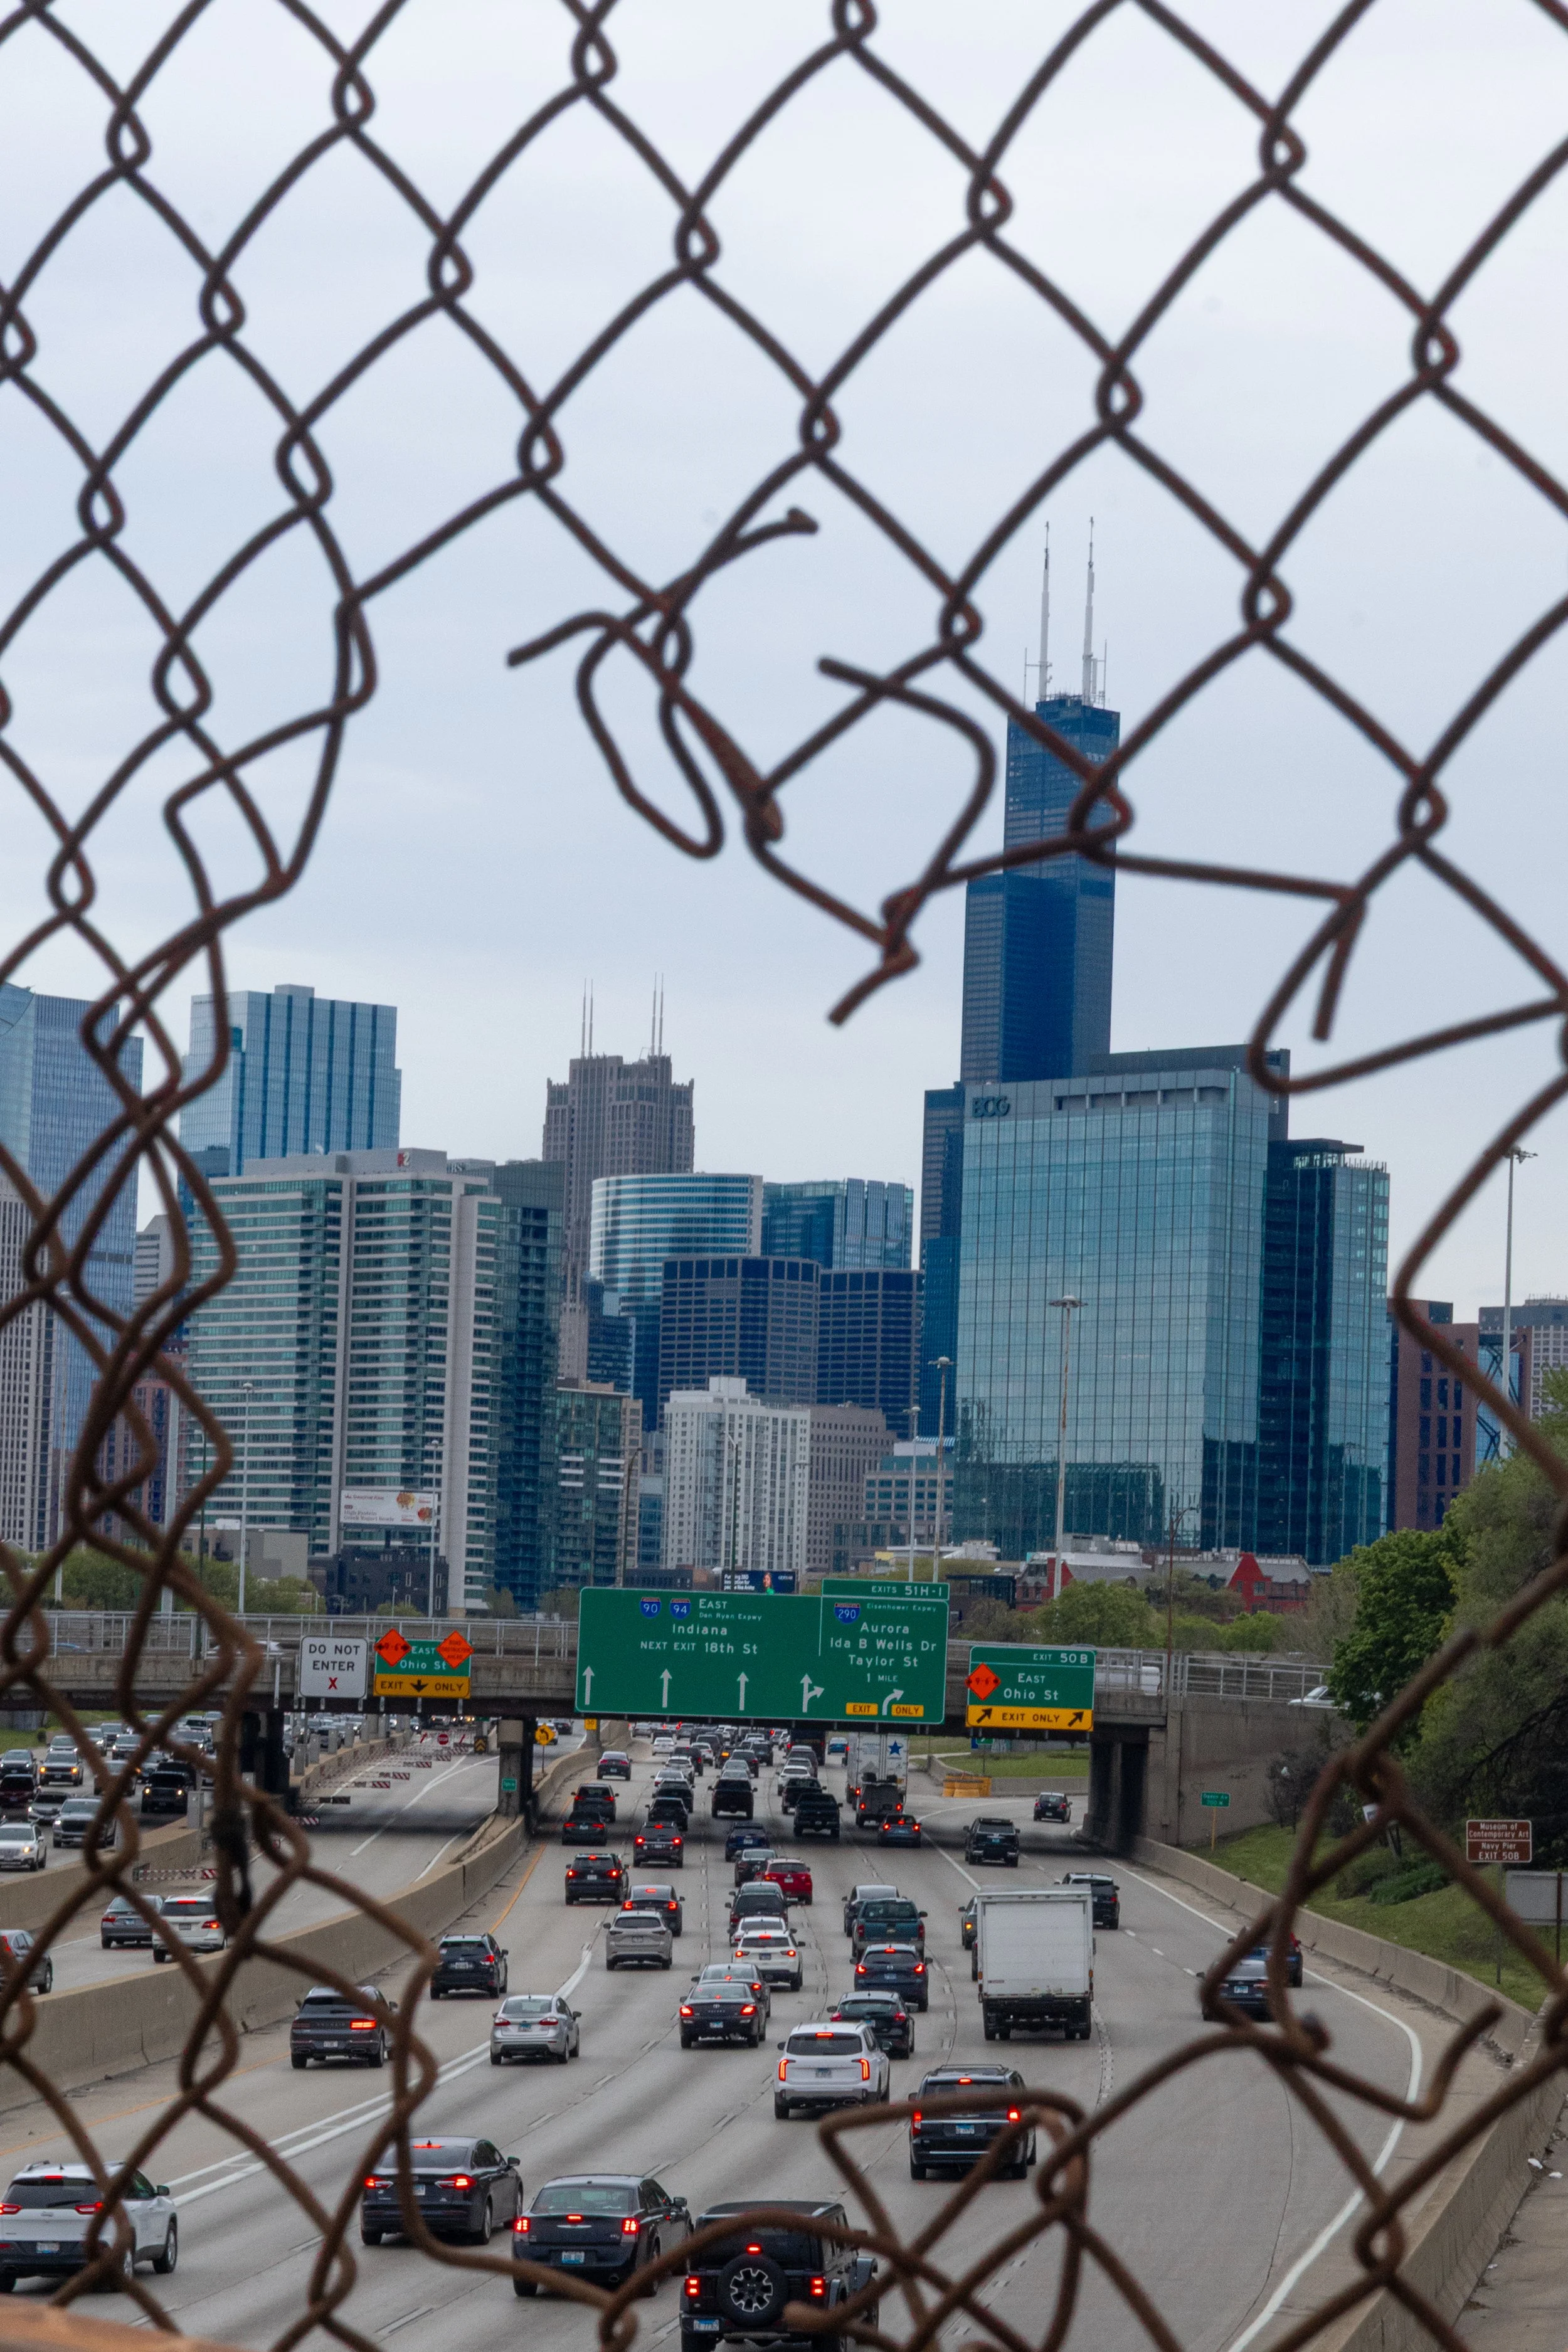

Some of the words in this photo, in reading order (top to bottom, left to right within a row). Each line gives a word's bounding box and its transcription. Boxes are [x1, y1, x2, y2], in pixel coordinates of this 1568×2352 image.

[972, 1095, 1010, 1118] BCG
[871, 1586, 897, 1594] EXITS
[644, 1603, 658, 1613] 90
[699, 1598, 728, 1609] EAST
[673, 1604, 687, 1614] 94
[838, 1609, 856, 1619] 290
[672, 1623, 728, 1635] Indiana
[860, 1622, 909, 1634] Aurora
[640, 1641, 668, 1650] NEXT
[674, 1642, 696, 1651] EXIT
[705, 1642, 734, 1653] 18th
[743, 1643, 758, 1654] St
[830, 1637, 850, 1648] Ida
[859, 1638, 867, 1649] B
[876, 1639, 913, 1651] Wells
[921, 1641, 936, 1651] Dr
[309, 1644, 326, 1654] DO
[334, 1645, 360, 1655] NOT
[411, 1646, 435, 1655] EAST
[312, 1660, 355, 1671] ENTER
[400, 1660, 427, 1669] Ohio
[433, 1661, 447, 1670] St
[849, 1654, 895, 1668] Taylor
[903, 1656, 918, 1667] St
[867, 1673, 871, 1682] 1
[1018, 1673, 1046, 1683] EAST
[381, 1680, 403, 1690] EXIT
[435, 1683, 464, 1692] ONLY
[1004, 1688, 1035, 1700] Ohio
[1044, 1690, 1059, 1700] St
[852, 1704, 871, 1713] EXIT
[895, 1705, 919, 1715] ONLY
[1002, 1713, 1025, 1722] EXIT
[1032, 1714, 1060, 1723] ONLY
[1469, 1831, 1515, 1839] Contemporary
[1481, 1842, 1499, 1850] Navy
[1478, 1852, 1497, 1860] EXIT
[1502, 1852, 1519, 1860] 50B
